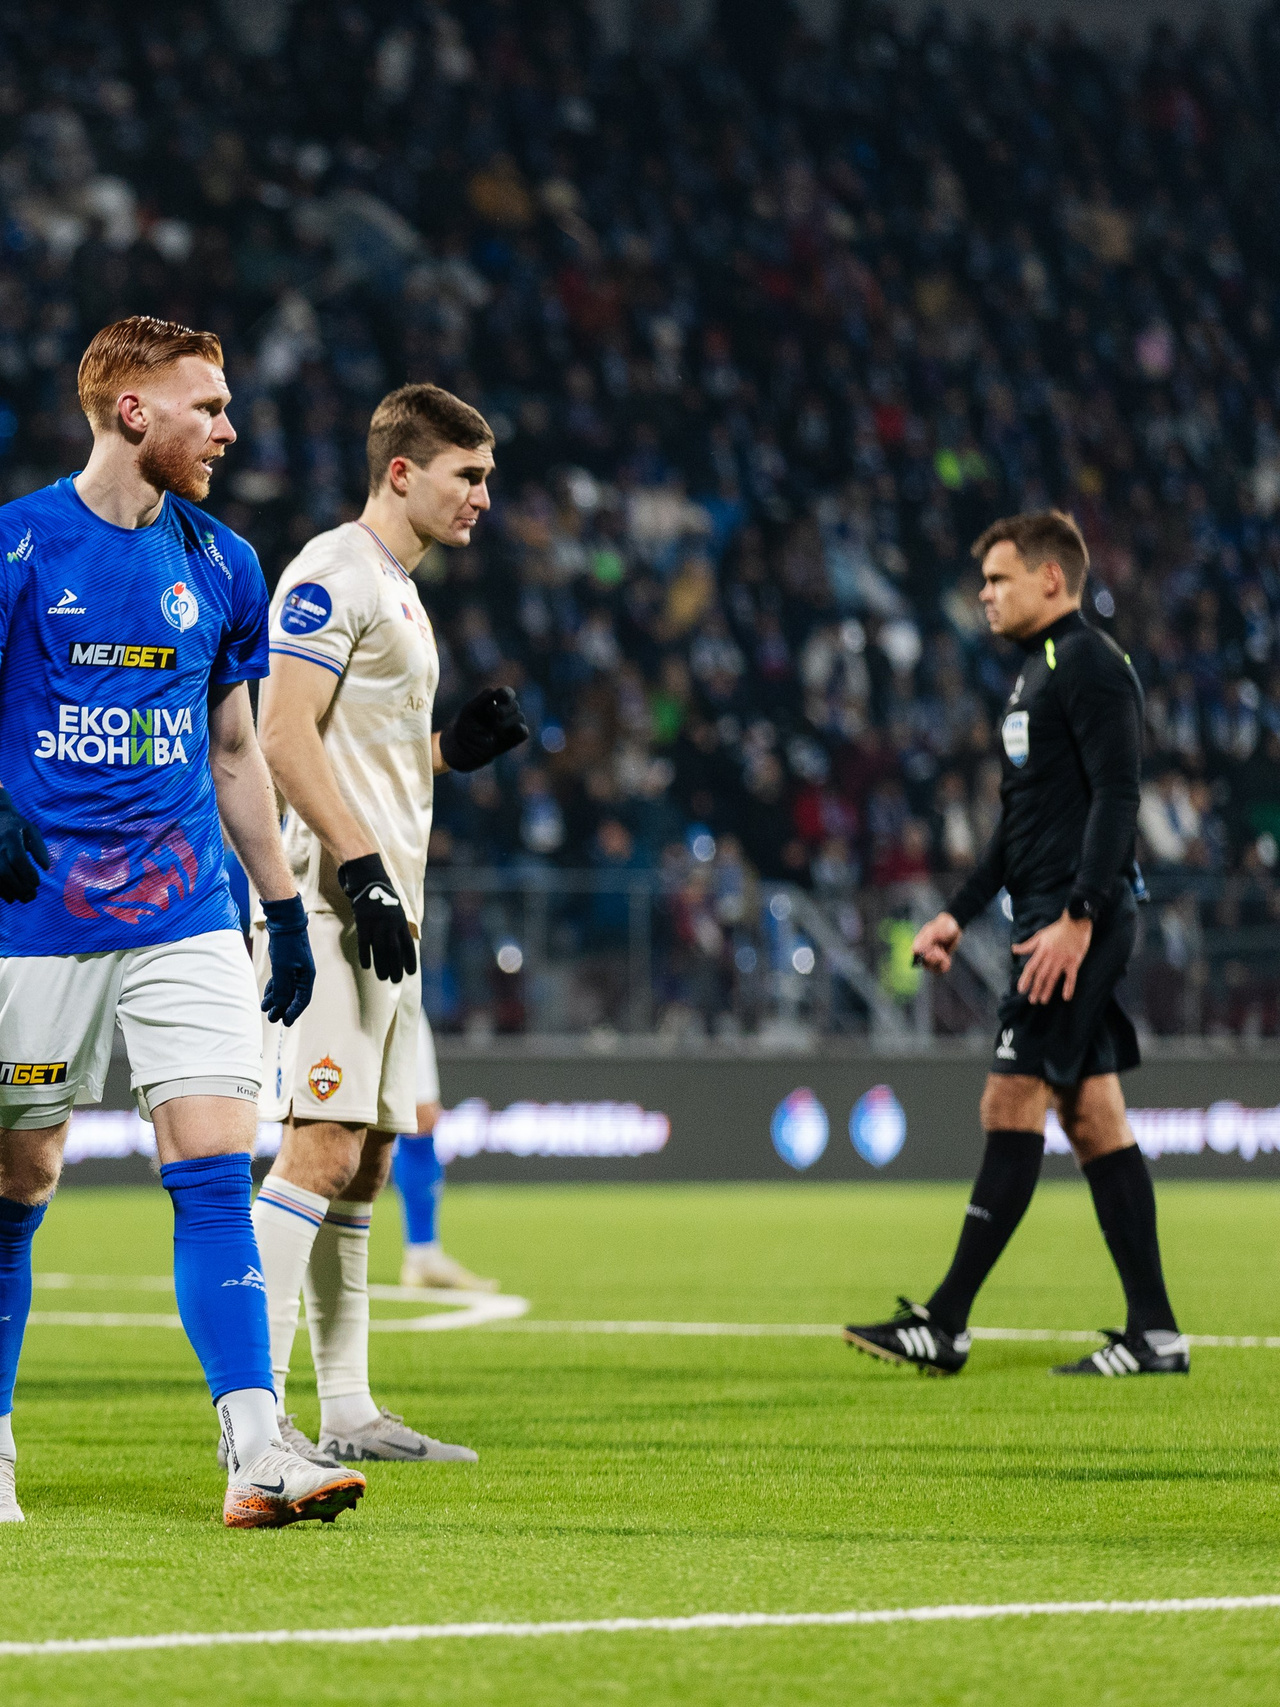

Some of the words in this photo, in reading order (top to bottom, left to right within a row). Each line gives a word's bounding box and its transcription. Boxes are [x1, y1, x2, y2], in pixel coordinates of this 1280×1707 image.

[47, 607, 87, 615] DEMIX
[70, 643, 175, 669] МЕЛБЕТ
[58, 704, 193, 736] EKONIVA
[34, 729, 189, 766] ЭКОНИВА
